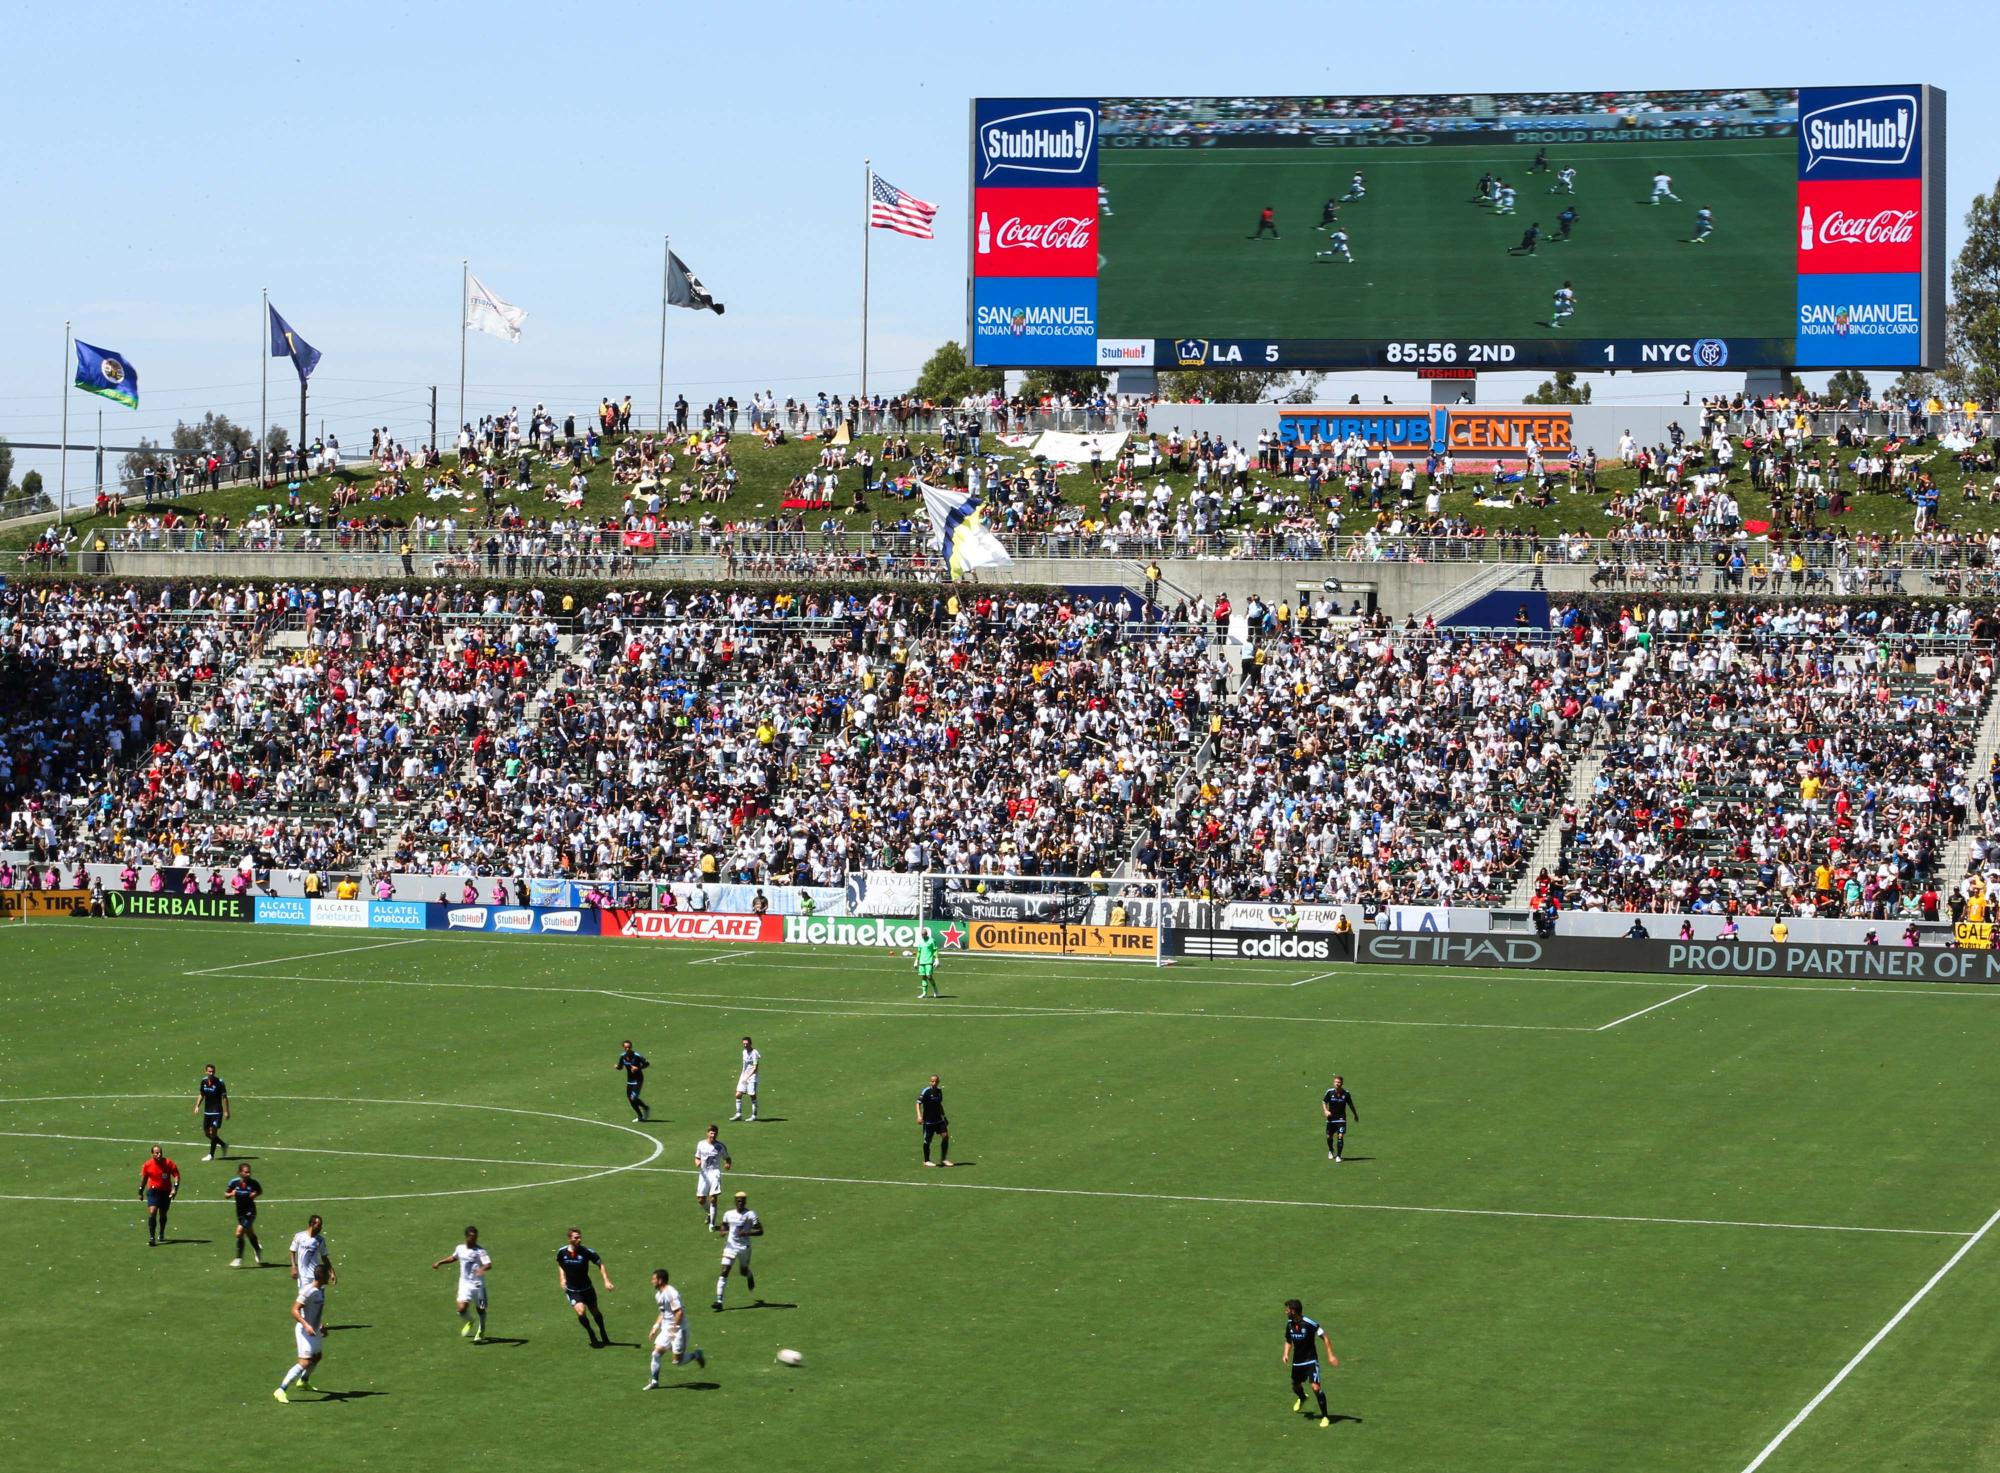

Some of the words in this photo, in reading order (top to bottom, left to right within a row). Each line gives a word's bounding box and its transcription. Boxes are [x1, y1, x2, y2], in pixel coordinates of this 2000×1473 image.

[1514, 131, 1587, 144] PROUD
[1593, 129, 1684, 142] PARTNER
[1689, 127, 1716, 139] OF
[1724, 126, 1765, 138] MLS
[1811, 108, 1908, 150] StubHub!
[988, 120, 1085, 159] StubHub!
[1107, 136, 1142, 148] OF
[1151, 136, 1190, 148] MLS
[1311, 134, 1432, 147] ETIHAD
[996, 217, 1095, 249] Coca-Cola
[1819, 210, 1919, 244] Coca-Cola
[977, 306, 1011, 324] SAN
[1026, 307, 1094, 324] MANUEL
[1801, 305, 1835, 323] SAN
[1849, 304, 1918, 323] MANUEL
[978, 326, 1011, 336] INDIAN
[1025, 326, 1054, 336] BINGO
[1062, 326, 1094, 336] CASINO
[1802, 324, 1835, 335] INDIAN
[1849, 324, 1877, 334] BINGO
[1886, 323, 1918, 334] CASINO
[1102, 345, 1146, 359] StubHub!
[1182, 347, 1201, 358] LA
[1213, 345, 1243, 361] LA
[1265, 345, 1279, 362] 5
[1386, 343, 1457, 362] 85:56
[1468, 345, 1516, 361] 2ND
[1603, 345, 1615, 361] 1
[1641, 344, 1691, 362] NYC
[1419, 369, 1474, 378] TOSHIBA
[1450, 419, 1570, 443] CENTER
[44, 896, 84, 910] TIRE
[130, 896, 240, 918] HERBALIFE
[259, 901, 303, 910] ALCATEL
[317, 904, 360, 913] ALCATEL
[374, 906, 418, 915] ALCATEL
[1366, 905, 1376, 915] 20
[450, 912, 484, 924] StubHub!
[497, 914, 531, 925] StubHub!
[544, 916, 578, 927] StubHub!
[1232, 906, 1264, 922] AMOR
[1300, 907, 1337, 923] TERNO
[629, 914, 758, 937] ADVOCARE
[786, 915, 932, 946] Heineken
[975, 924, 1086, 949] Continental
[1109, 933, 1153, 949] TIRE
[1242, 935, 1329, 959] adidas
[1369, 935, 1542, 963] ETIHAD
[1668, 945, 1777, 972] PROUD
[1787, 949, 1924, 976] PARTNER
[1934, 952, 1977, 978] OF
